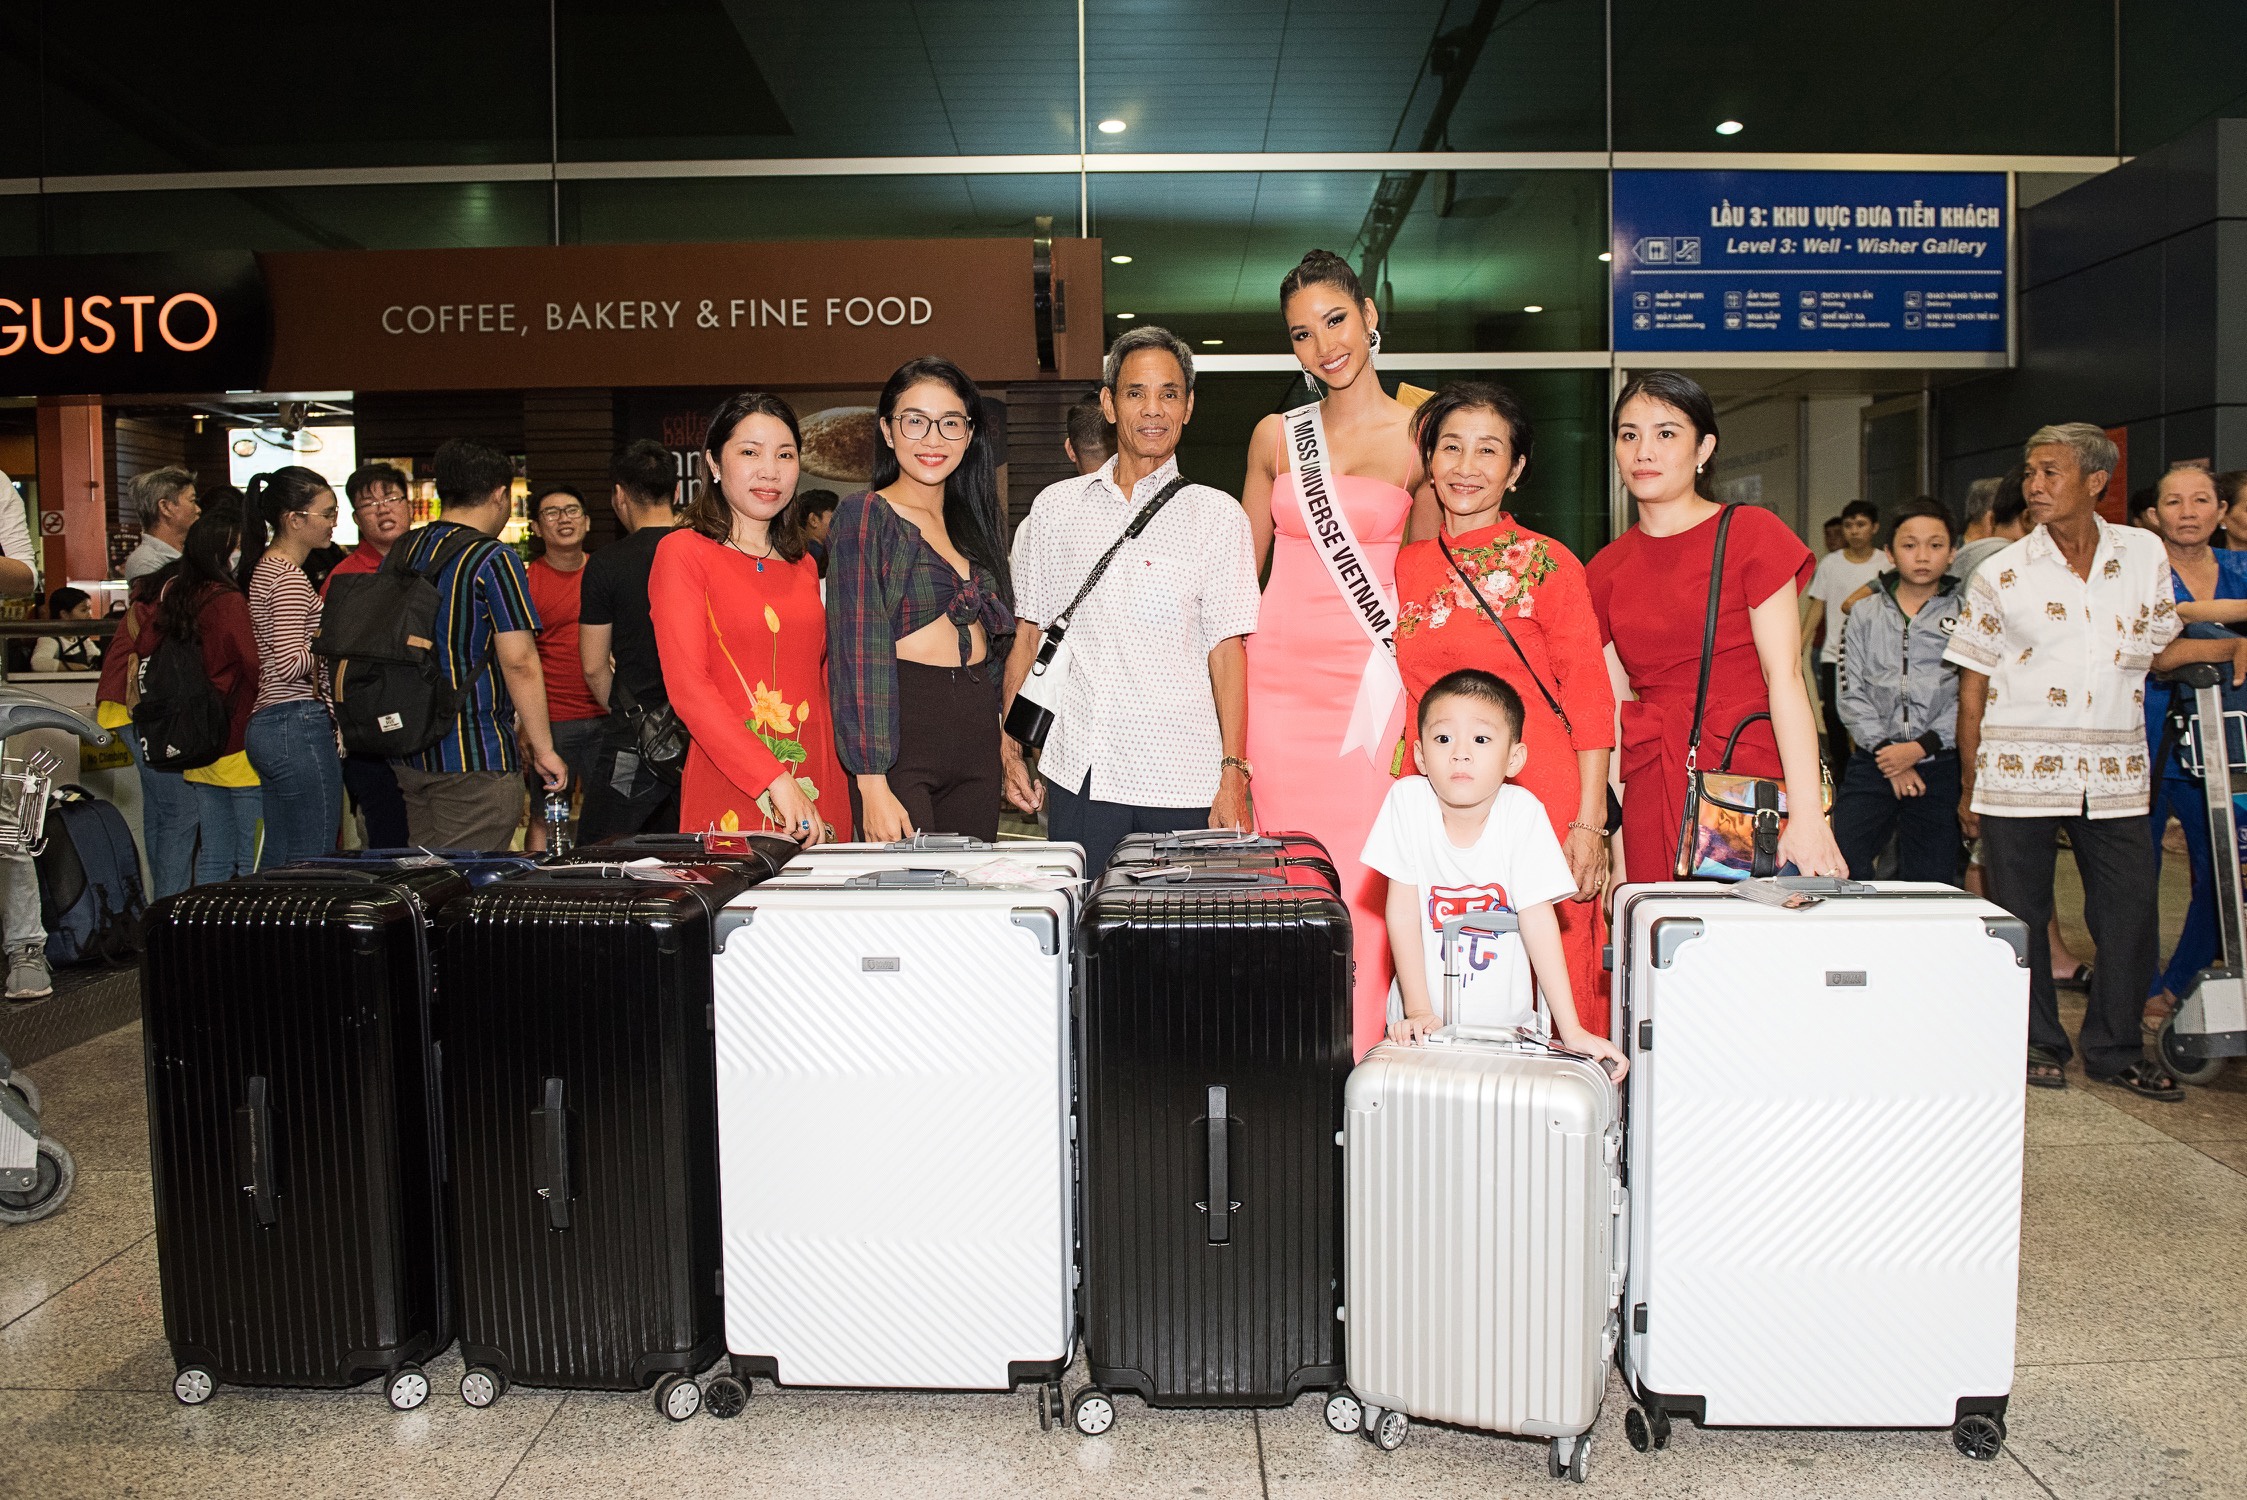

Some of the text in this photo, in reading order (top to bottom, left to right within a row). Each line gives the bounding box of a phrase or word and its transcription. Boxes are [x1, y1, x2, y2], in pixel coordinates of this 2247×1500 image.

[1710, 199, 2000, 231] LẦU 3: KHU VỰC ĐƯA TIỄN KHÁCH
[1727, 237, 1775, 254] Level
[1779, 238, 1797, 254] 3:
[1803, 237, 1841, 254] Well
[1857, 237, 1919, 254] Wisher
[1922, 238, 1987, 258] Gallery
[381, 296, 933, 337] COFFEE, BAKERY & FINE FOOD
[1293, 419, 1319, 462] MISS
[1300, 460, 1346, 549] UNIVERSE
[1332, 546, 1394, 633] VIETNAM
